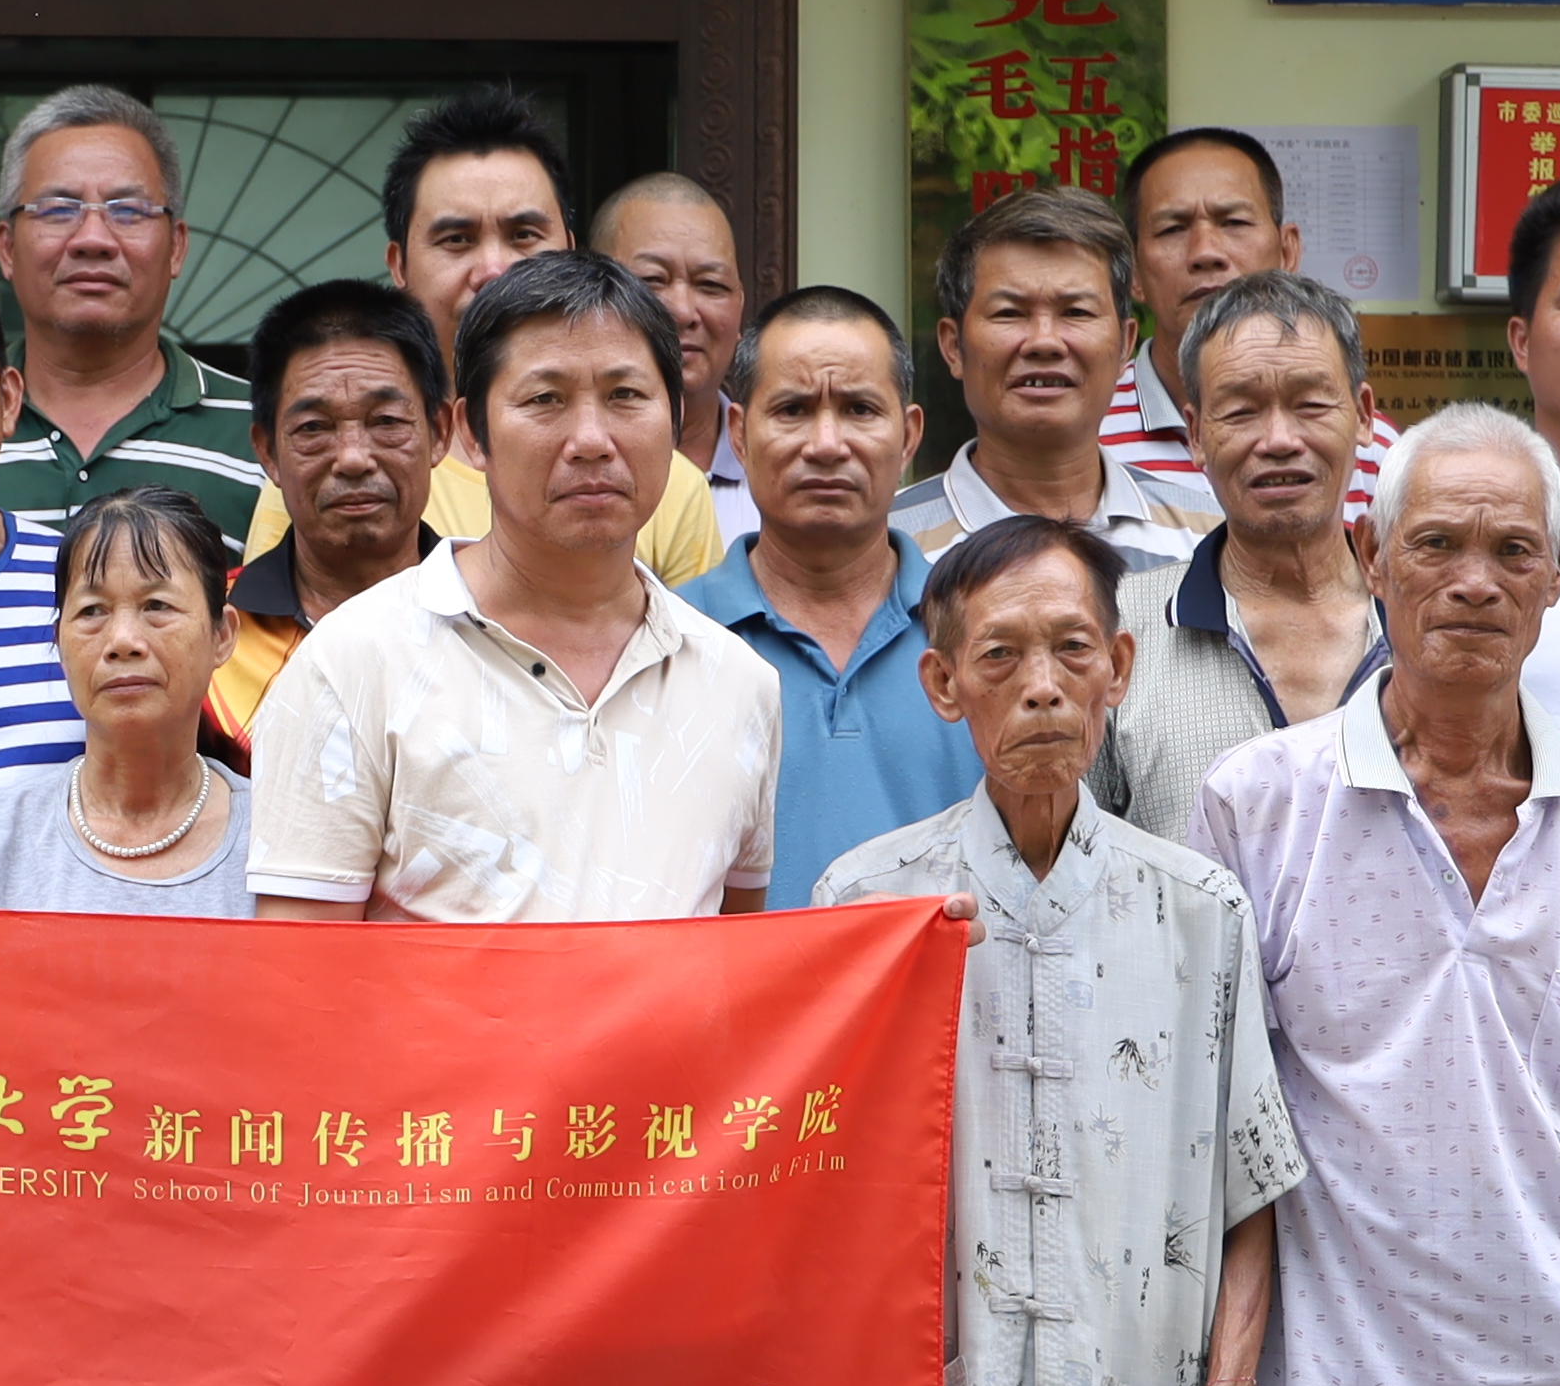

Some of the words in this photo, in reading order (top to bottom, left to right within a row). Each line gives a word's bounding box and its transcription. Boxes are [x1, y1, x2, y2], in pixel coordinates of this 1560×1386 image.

[142, 1083, 844, 1168] 新闻传播与影视学院
[132, 1177, 234, 1204] School
[250, 1181, 282, 1204] Of
[296, 1181, 472, 1207] Journalism
[484, 1177, 534, 1203] and
[545, 1171, 760, 1201] Communication
[768, 1163, 781, 1184] &
[788, 1151, 846, 1177] Film
